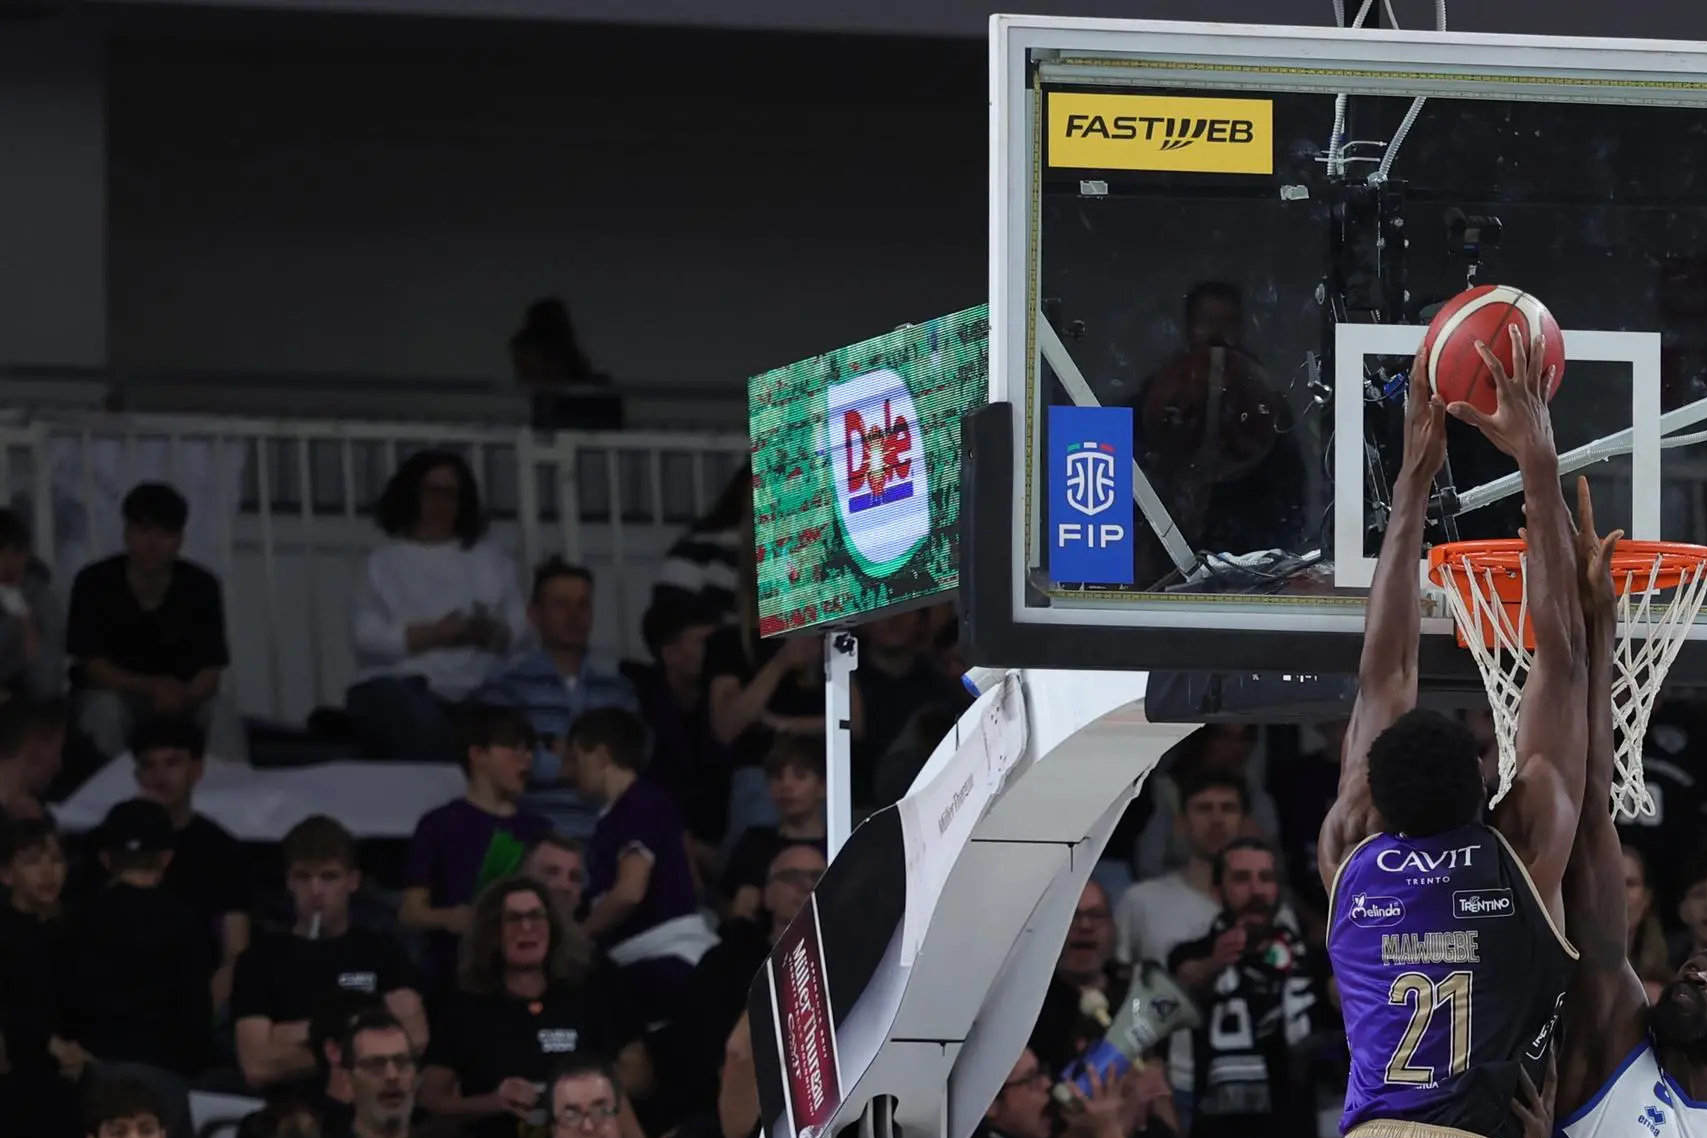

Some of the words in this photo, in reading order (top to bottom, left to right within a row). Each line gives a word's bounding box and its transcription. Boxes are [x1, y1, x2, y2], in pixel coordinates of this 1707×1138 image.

[1065, 113, 1254, 151] FASTWEB
[845, 399, 912, 493] Dole
[1057, 523, 1125, 549] FIP
[1376, 845, 1482, 873] CAVIT
[1406, 875, 1451, 885] TRENTO
[1459, 896, 1511, 913] TRENTINO
[1381, 930, 1481, 966] MAWUGBE
[1384, 970, 1474, 1086] 21
